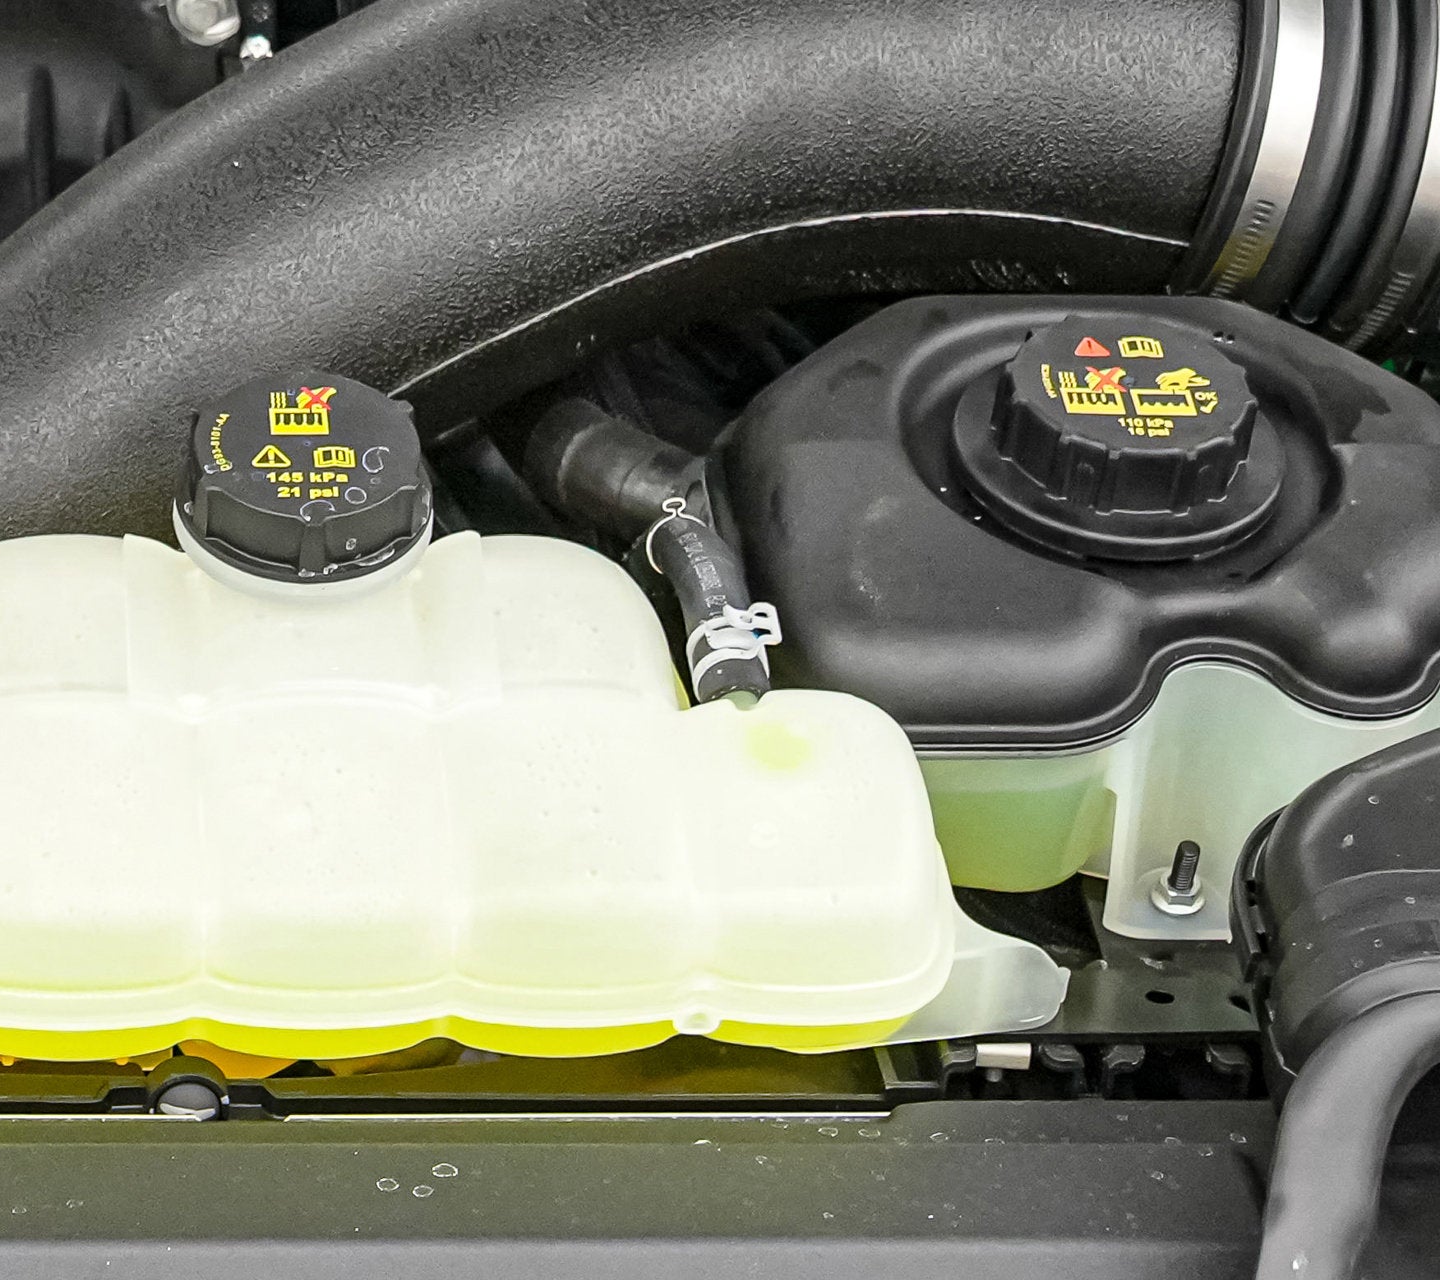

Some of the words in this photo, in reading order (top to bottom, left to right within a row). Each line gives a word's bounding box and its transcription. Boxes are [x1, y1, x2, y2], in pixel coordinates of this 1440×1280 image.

[1194, 391, 1218, 401] OK
[1117, 417, 1144, 428] 110
[265, 471, 304, 484] 145
[309, 471, 349, 484] kPa
[276, 486, 301, 499] 21
[309, 486, 340, 500] psi
